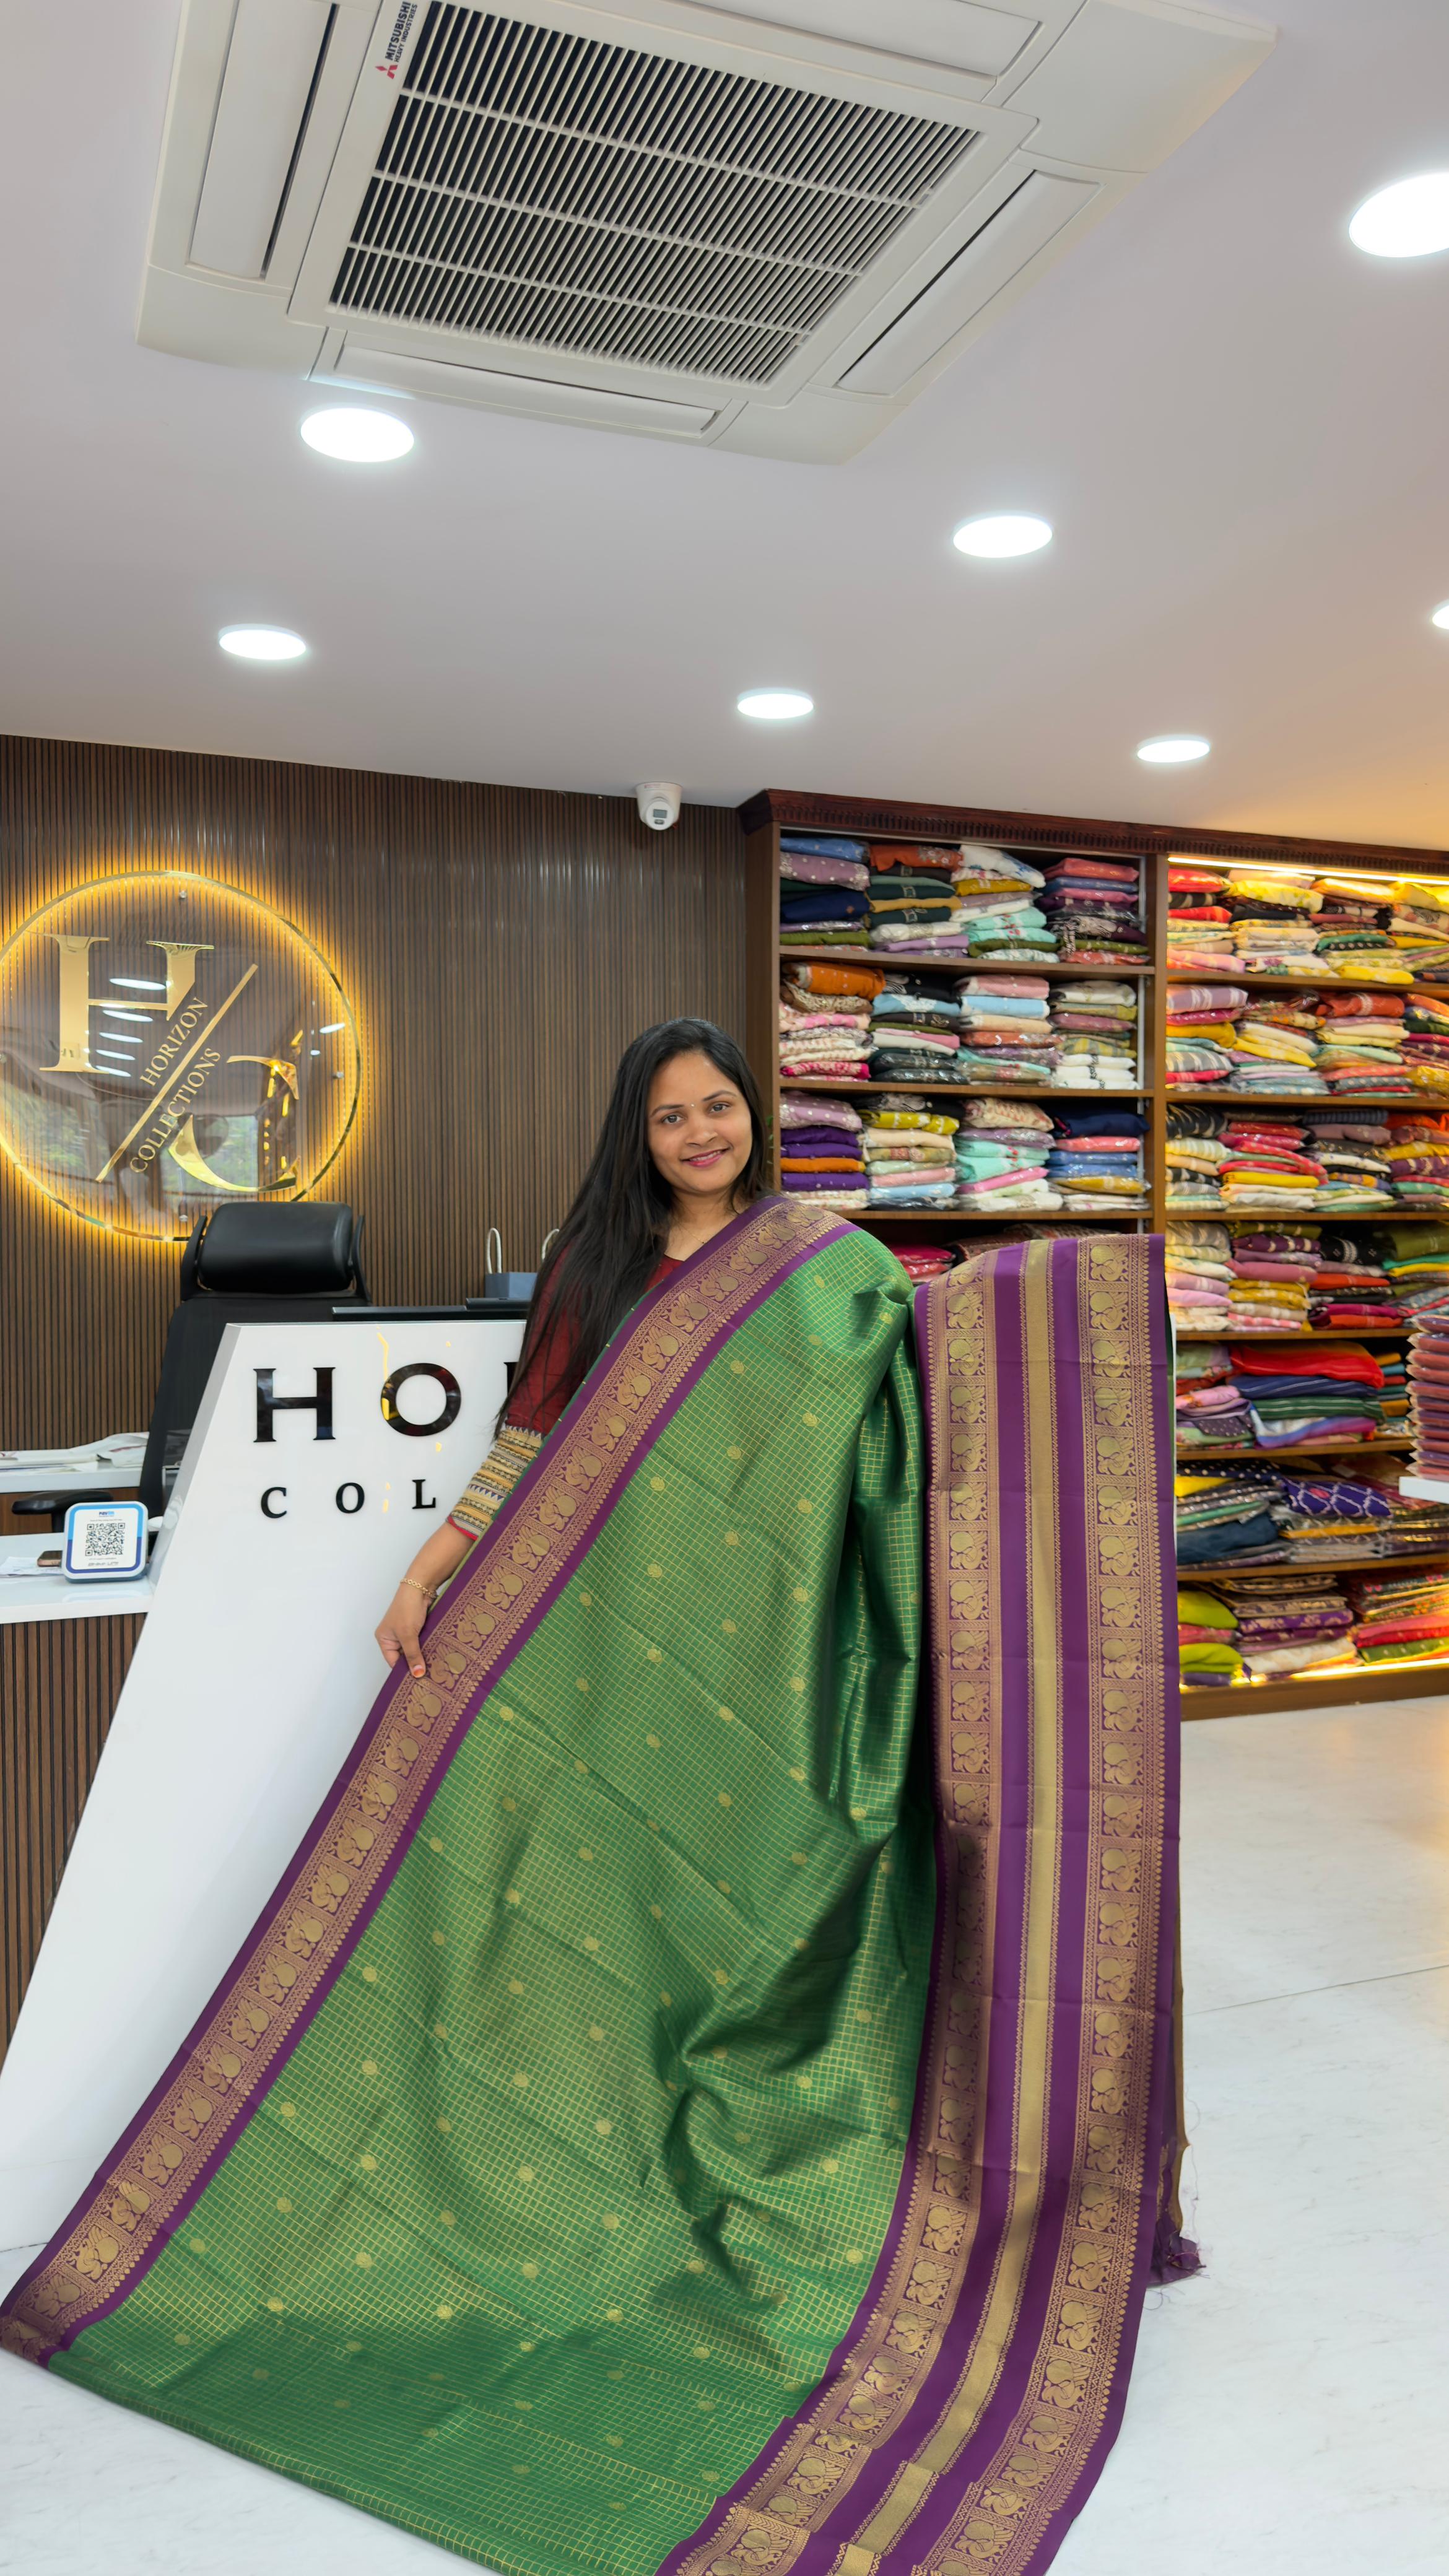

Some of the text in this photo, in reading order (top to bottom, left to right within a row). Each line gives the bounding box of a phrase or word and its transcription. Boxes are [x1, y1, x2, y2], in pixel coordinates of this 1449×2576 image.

[385, 1, 411, 61] MITSUBISHI
[394, 4, 418, 63] HEAVY INDUSTRIES
[140, 997, 208, 1087] HORIZON
[130, 1048, 221, 1173] COLLECTIONS
[253, 1362, 520, 1443] HO
[261, 1479, 436, 1518] COL
